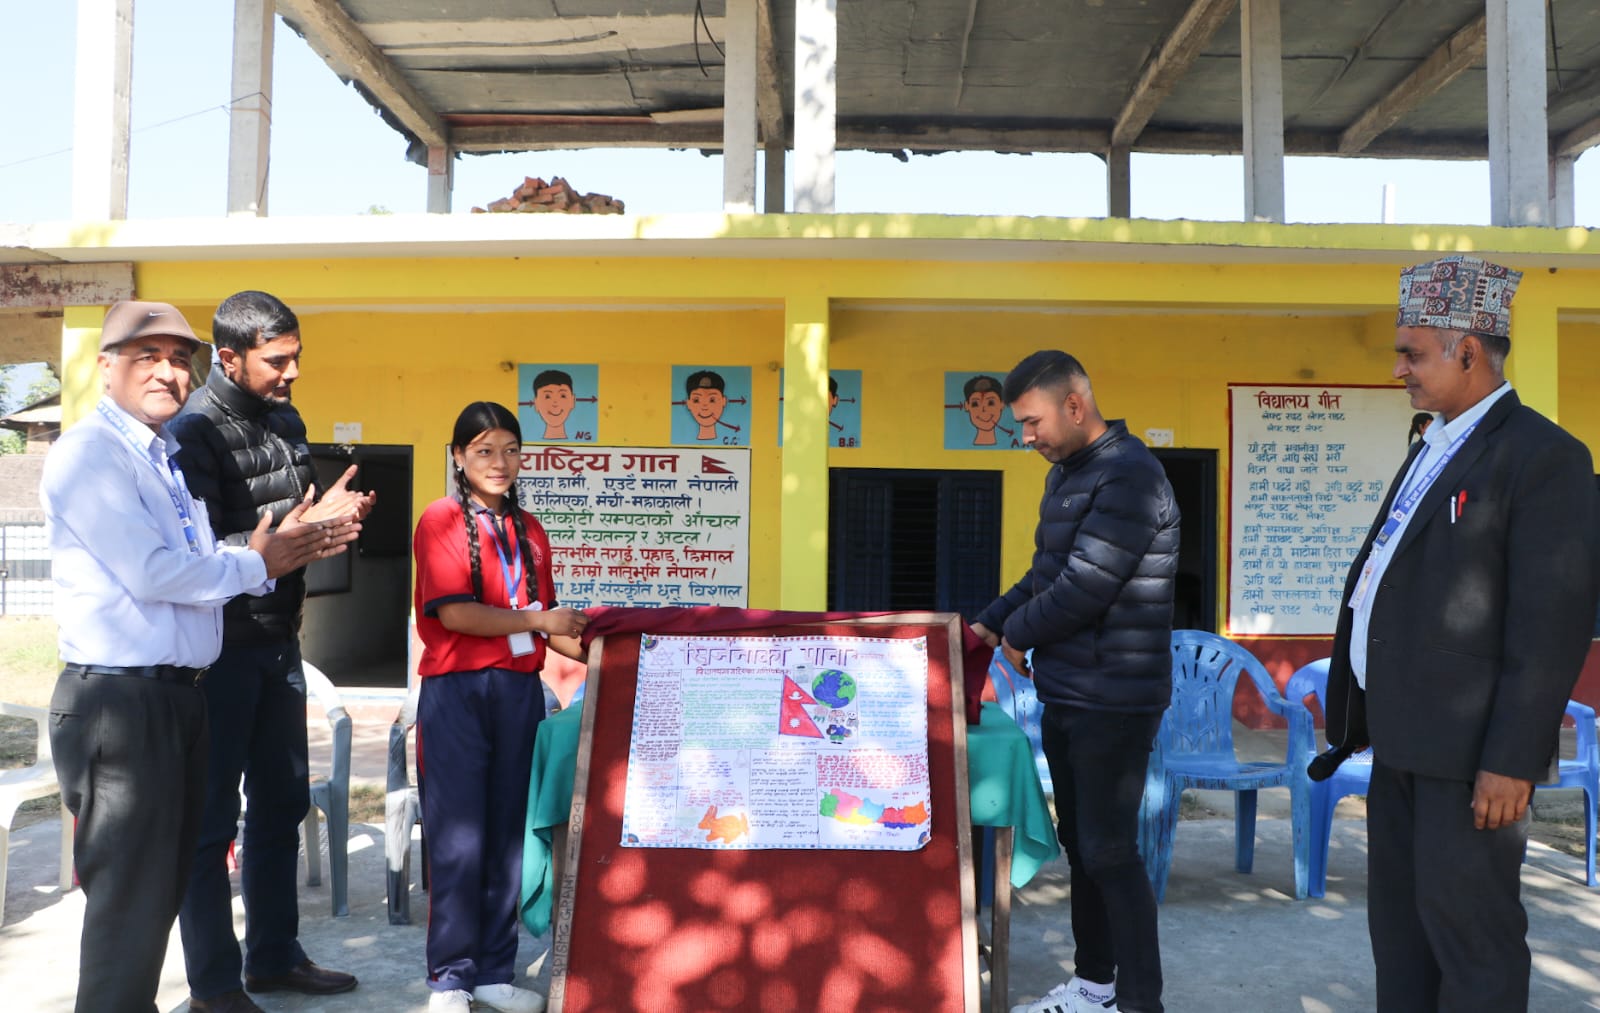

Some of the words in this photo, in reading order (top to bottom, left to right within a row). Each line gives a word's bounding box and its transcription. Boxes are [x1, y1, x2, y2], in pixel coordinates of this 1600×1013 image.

[1254, 391, 1310, 409] विद्यालय
[1317, 390, 1342, 410] गीत
[621, 454, 680, 473] गान
[604, 473, 636, 492] एउटै
[641, 479, 678, 492] माला
[687, 475, 738, 493] नेपाली
[600, 511, 673, 527] सम्पदाको
[641, 531, 649, 544] र
[656, 532, 701, 545] अटल
[683, 546, 734, 563] हिमाल
[571, 562, 602, 578] हाम्रो
[666, 563, 708, 579] नेपाल
[688, 581, 742, 600] विशाल
